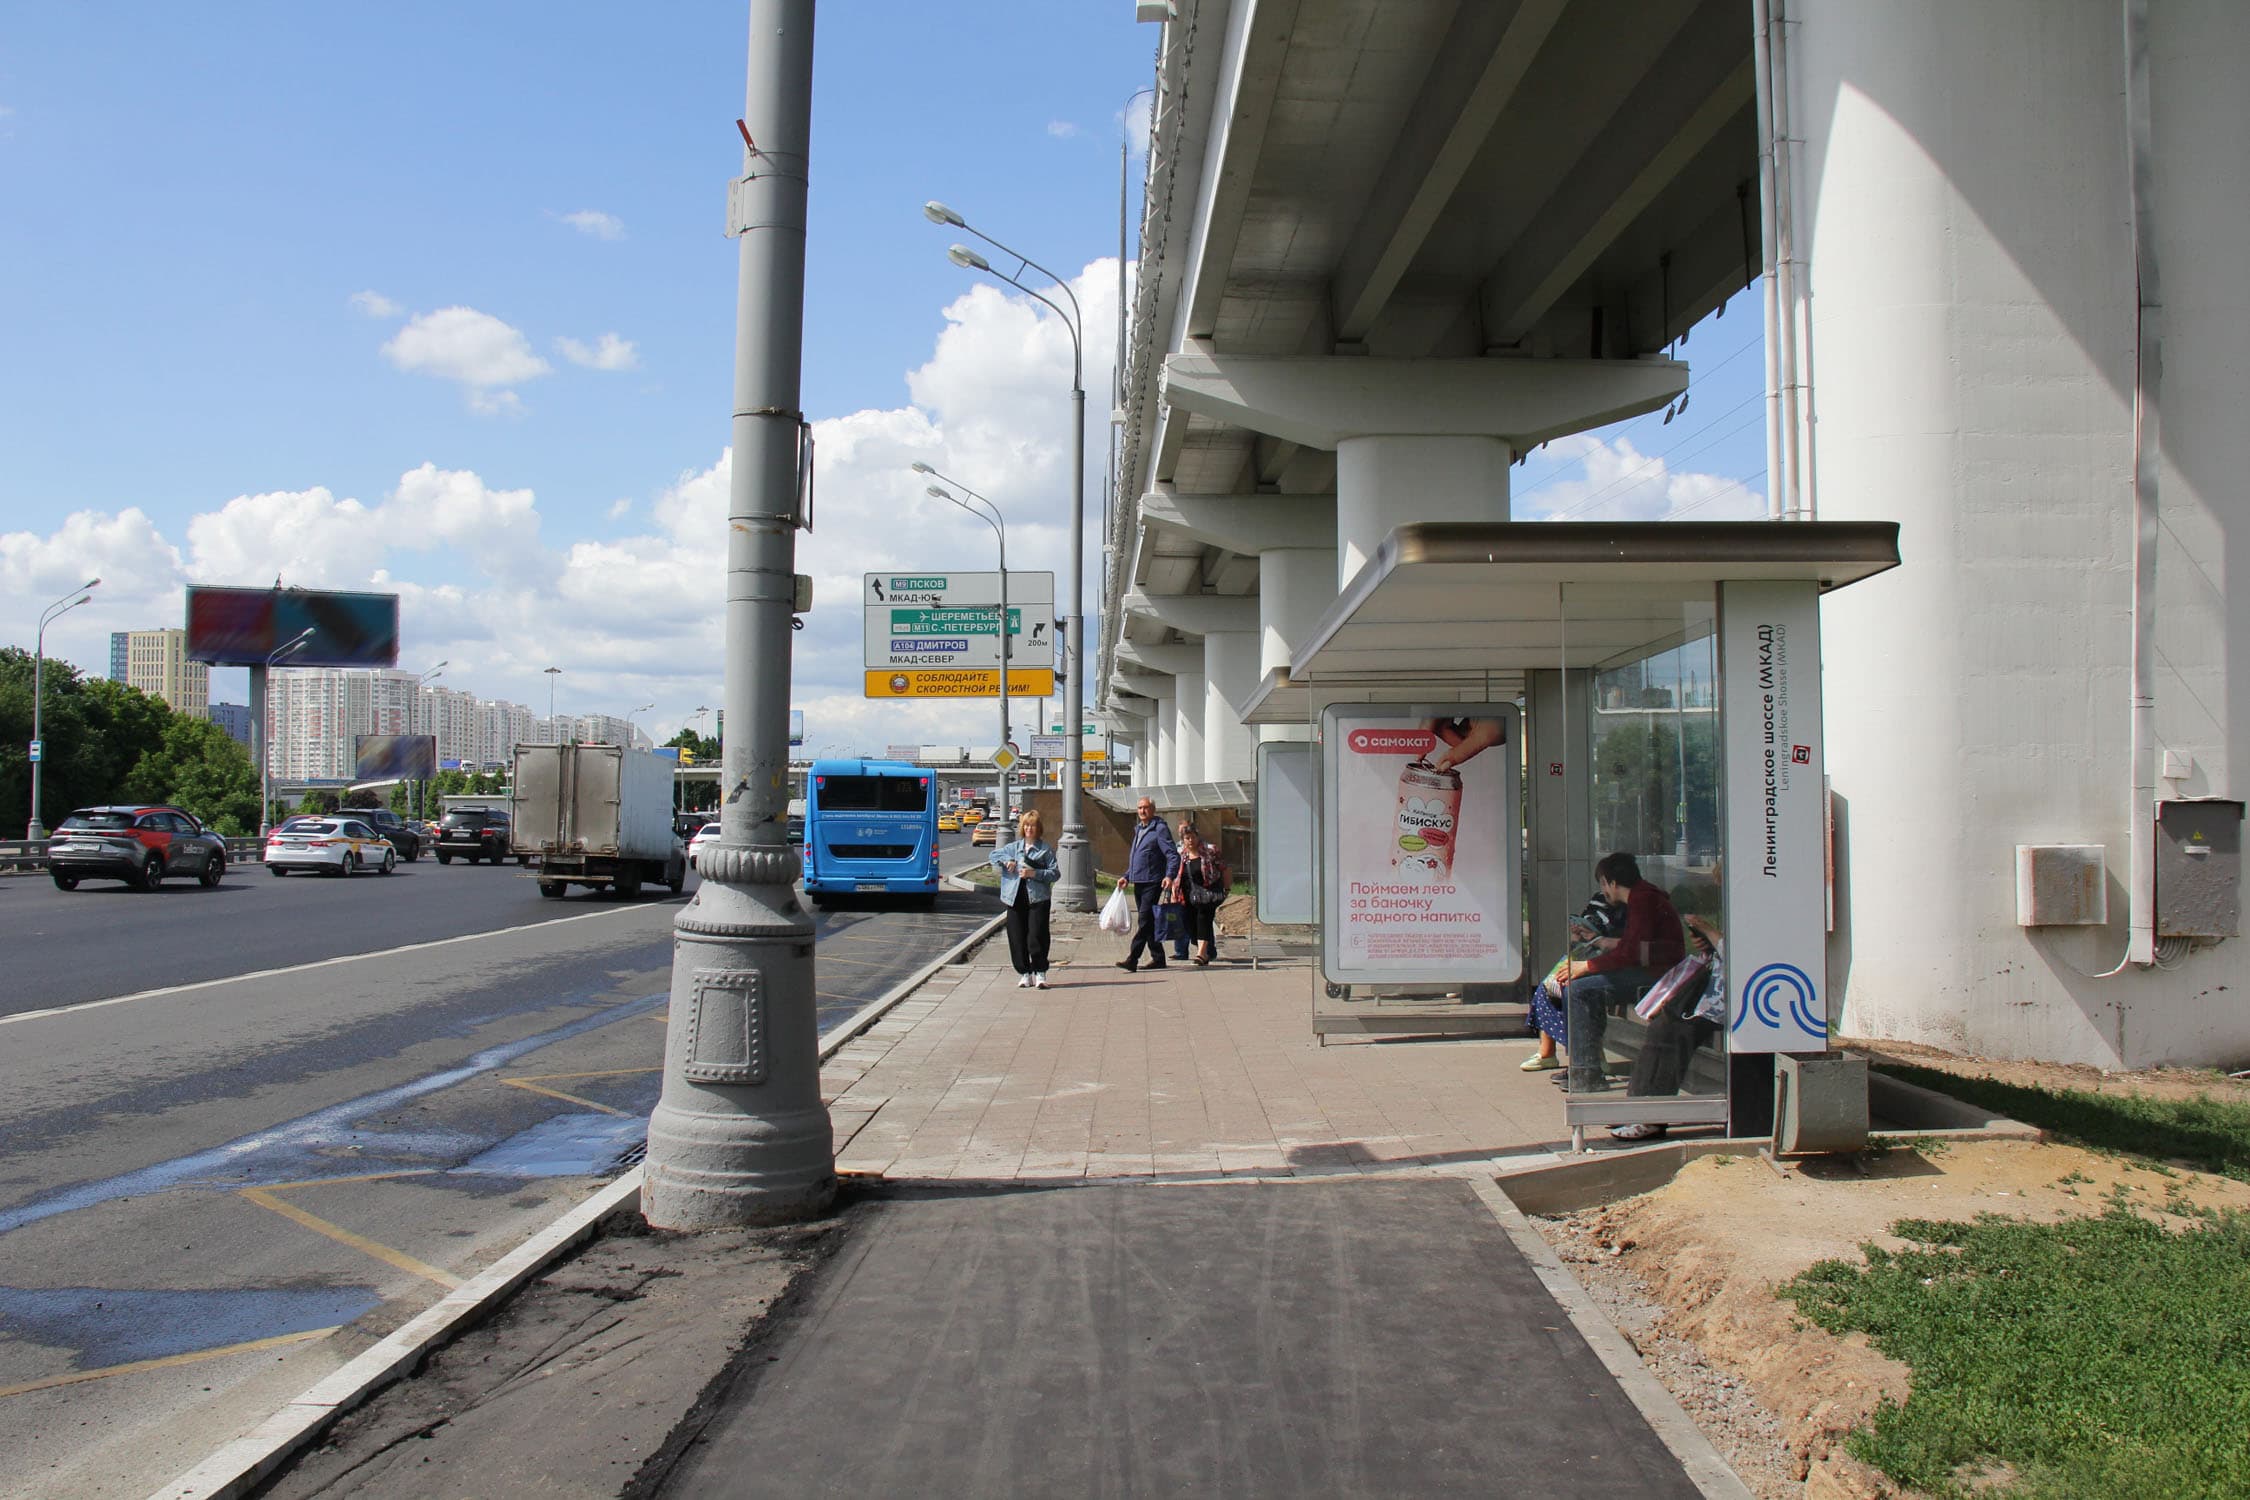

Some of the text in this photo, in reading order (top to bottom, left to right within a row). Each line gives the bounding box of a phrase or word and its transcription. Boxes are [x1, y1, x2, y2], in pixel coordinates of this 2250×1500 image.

[909, 579, 945, 589] ПСКОВ
[931, 612, 1008, 621] ШЕРЕМЕТЬЕВ
[931, 623, 1001, 632] С.-ПЕТЕРБУРГ
[916, 640, 966, 651] ДМИТРОВ
[889, 655, 955, 664] МКАД-СЕВЕР
[916, 673, 989, 682] СОБЛЮДАЙТЕ
[916, 683, 986, 693] СКОРОСТНОЙ
[1777, 623, 1791, 791] Leningradskoe Shosse (MKAD)
[1371, 736, 1430, 748] самокат
[1757, 624, 1778, 878] Ленинградское шоссе (МКАД)
[1400, 814, 1452, 828] ГИБИСКУС
[1350, 881, 1457, 895] Поймаем лето
[1350, 896, 1433, 911] за баночку
[1350, 913, 1481, 925] ягодного напитка
